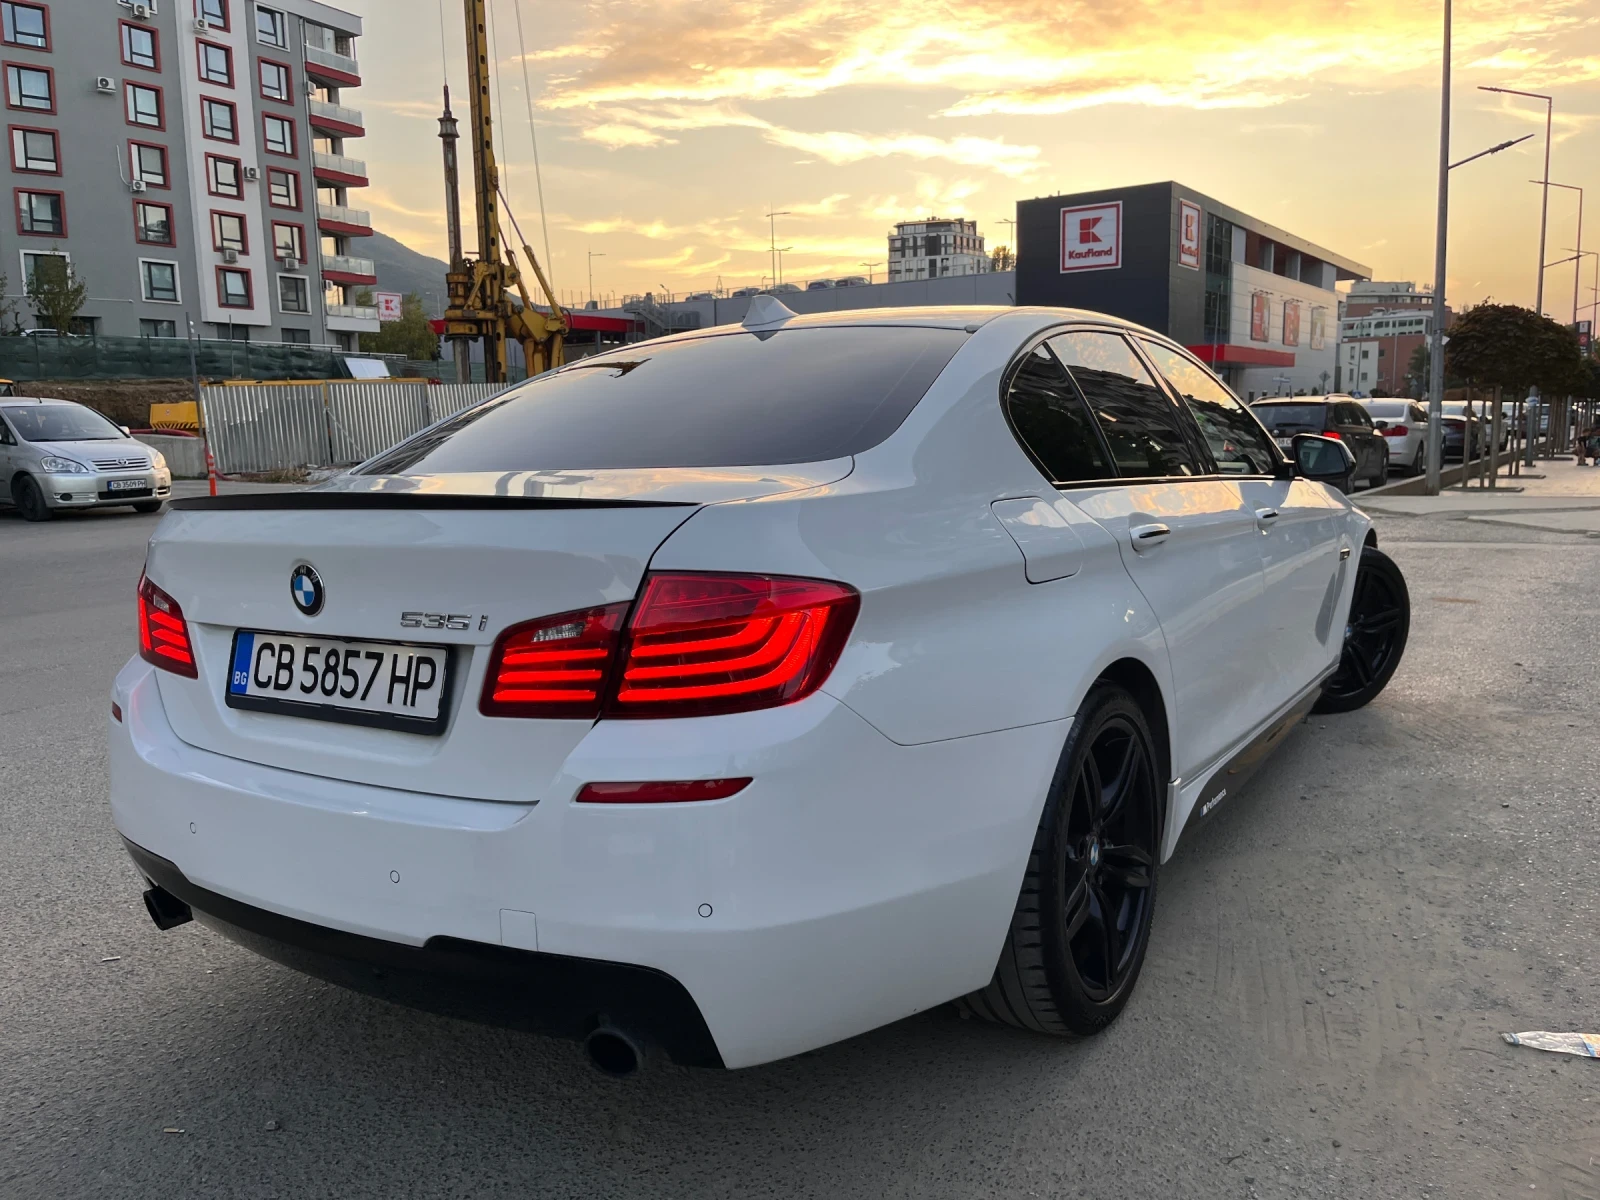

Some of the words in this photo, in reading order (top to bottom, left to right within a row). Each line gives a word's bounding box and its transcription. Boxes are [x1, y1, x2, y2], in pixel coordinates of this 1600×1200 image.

[1068, 246, 1112, 260] Kaufland
[233, 671, 248, 686] BG
[253, 642, 295, 691] CB
[299, 645, 385, 701] 5857
[387, 653, 437, 707] HP
